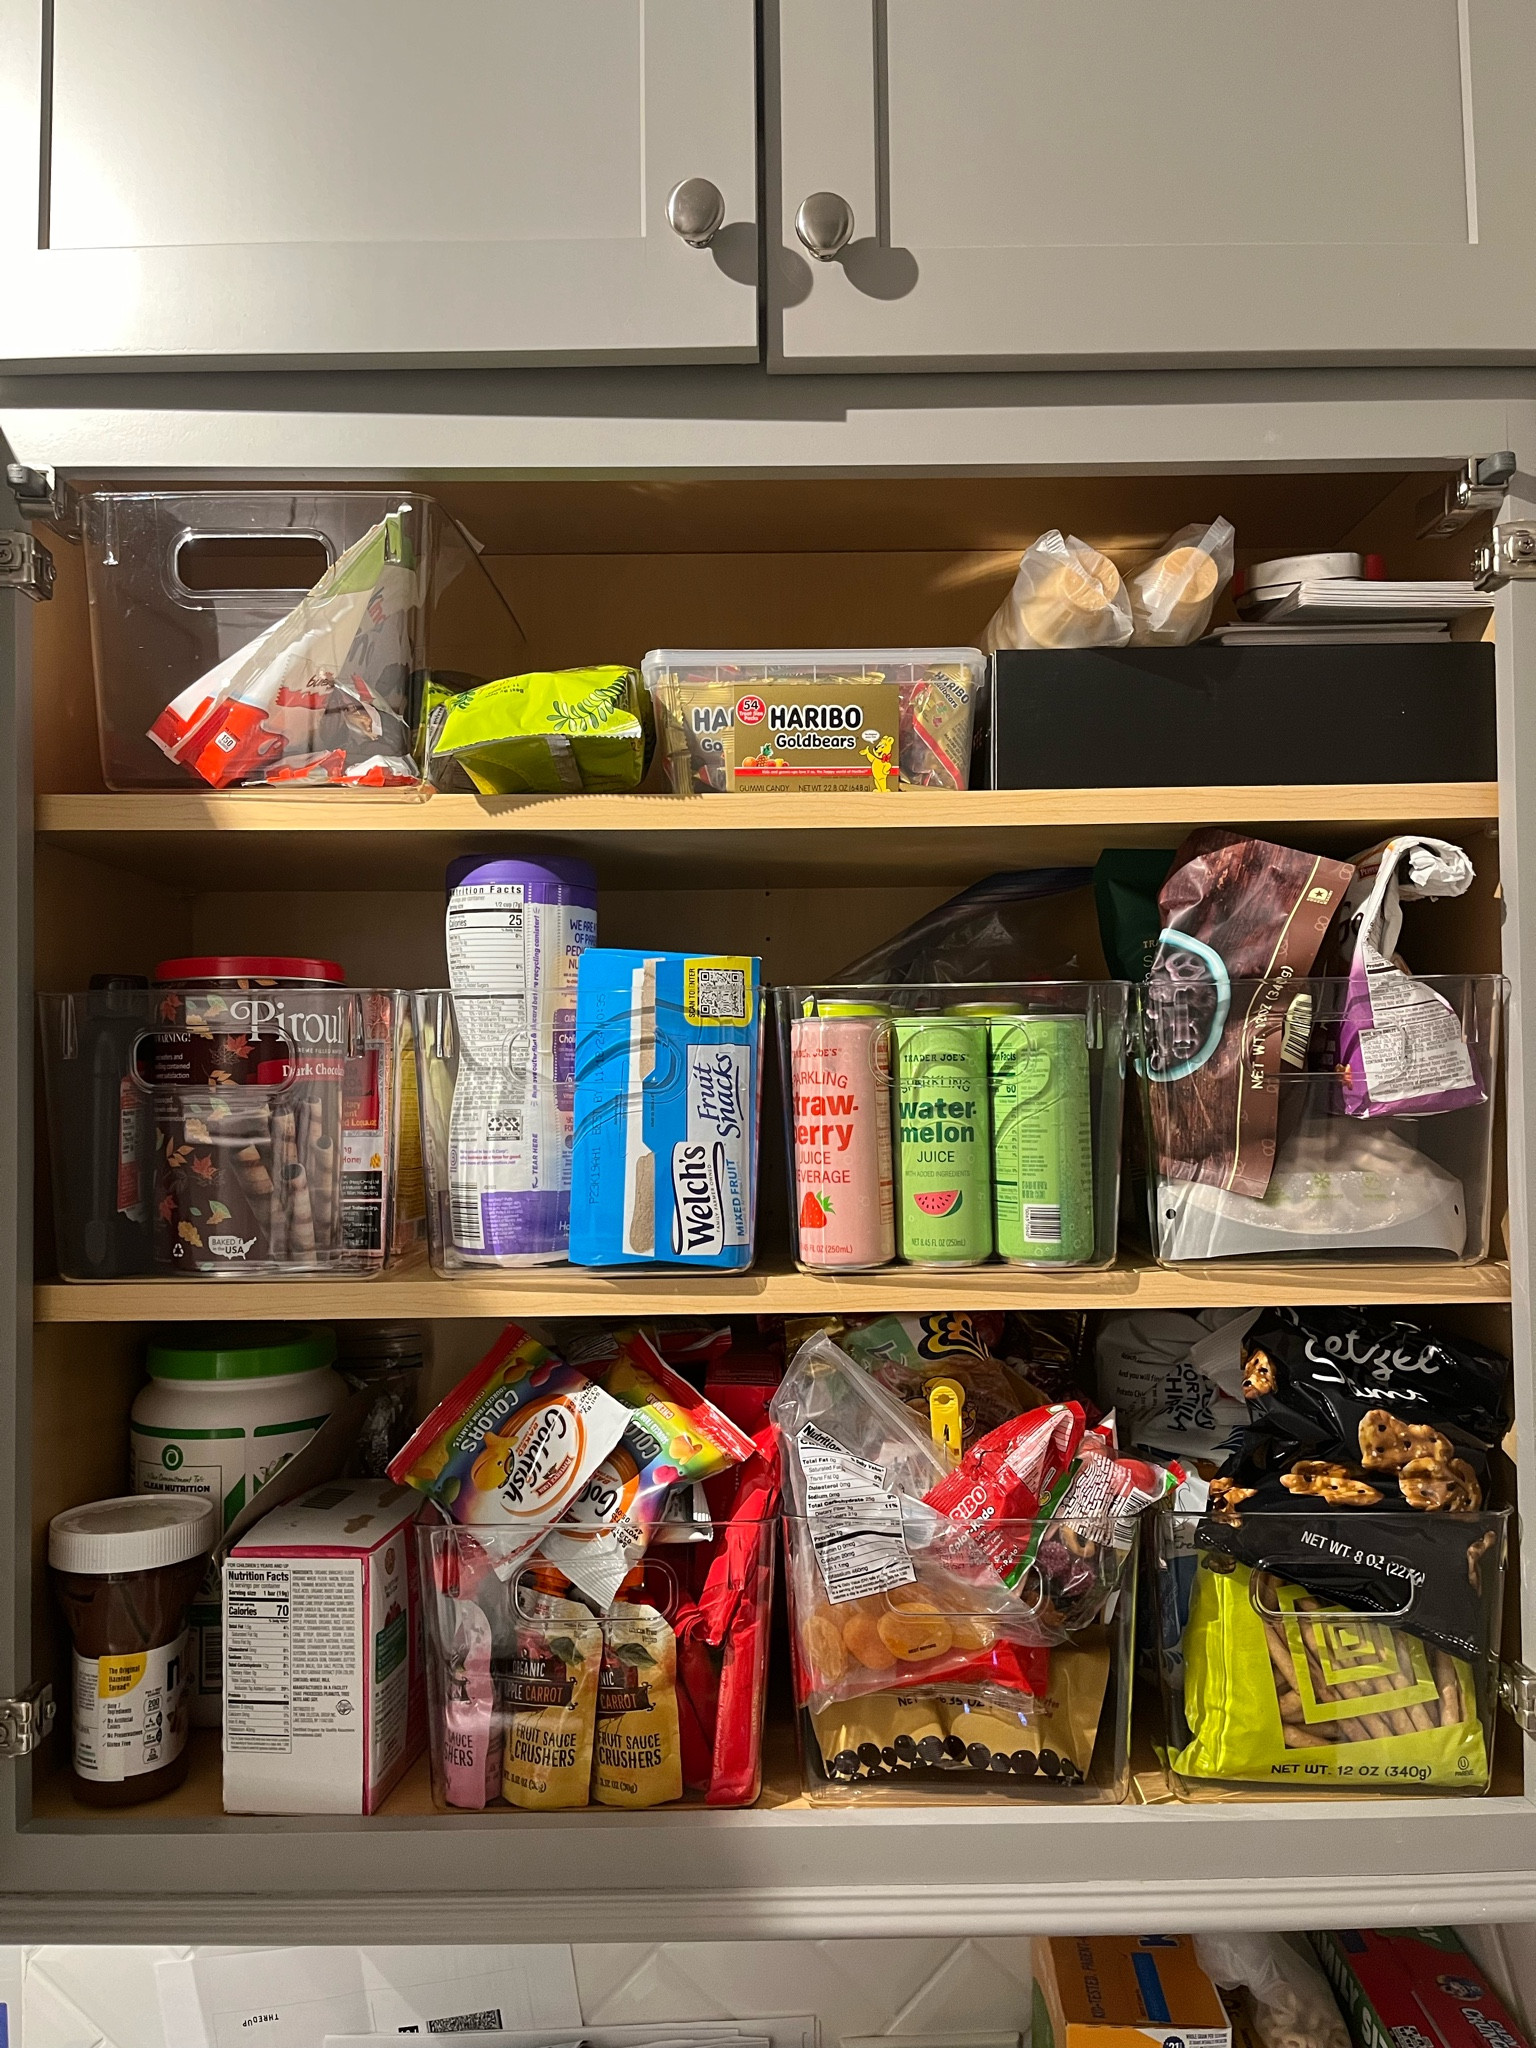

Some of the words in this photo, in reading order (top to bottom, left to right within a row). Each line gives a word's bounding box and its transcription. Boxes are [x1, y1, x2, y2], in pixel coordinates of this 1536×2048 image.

[743, 700, 759, 710] 54
[769, 706, 863, 730] HARIBO
[220, 734, 234, 747] 150
[776, 734, 856, 749] Goldbears
[740, 784, 764, 792] GUMMI
[766, 784, 790, 792] CANDY
[799, 784, 810, 792] NET
[839, 784, 848, 792] OZ
[848, 784, 870, 792] (648g)
[490, 886, 522, 894] Facts
[509, 914, 522, 926] 25
[570, 918, 582, 931] WE
[532, 916, 540, 947] canister!
[574, 932, 585, 944] OF
[532, 948, 540, 981] recycling
[688, 990, 695, 999] TO
[1253, 1032, 1266, 1056] WT.
[904, 1054, 937, 1063] TRADER
[940, 1053, 966, 1062] JOE'S
[1000, 1052, 1017, 1060] Facts
[1250, 1062, 1264, 1090] NET
[698, 1062, 714, 1121] Fruit
[1006, 1084, 1016, 1094] 60
[716, 1053, 741, 1139] Snacks
[900, 1122, 975, 1143] melon
[916, 1150, 956, 1163] JUICE
[726, 1159, 739, 1195] FRUIT
[917, 1170, 935, 1178] ADDED
[936, 1170, 971, 1178] INGREDIENTS
[679, 1144, 715, 1250] Welch's
[731, 1198, 745, 1237] MIXED
[212, 1238, 236, 1246] BAKED
[912, 1238, 920, 1247] NET
[920, 1238, 931, 1248] 8.45
[932, 1238, 938, 1247] FL
[938, 1238, 946, 1248] OZ
[946, 1238, 966, 1248] (250mL)
[226, 1246, 245, 1254] USA
[825, 1244, 853, 1254] (250mL)
[1118, 1370, 1128, 1378] And
[1129, 1372, 1140, 1380] you
[484, 1386, 507, 1409] SOURCED
[1116, 1387, 1134, 1396] Potato
[645, 1392, 674, 1420] CHEDDAR
[474, 1406, 486, 1420] FROM
[460, 1390, 519, 1453] COLORS
[456, 1418, 474, 1442] PLANTS
[516, 1422, 539, 1457] BAKED
[143, 1481, 164, 1490] CLEAN
[164, 1484, 210, 1493] NUTRITION
[824, 1498, 864, 1506] Carbohydrate
[815, 1509, 832, 1517] Dietary
[814, 1532, 836, 1542] Protein
[1300, 1530, 1328, 1549] NET
[1329, 1540, 1352, 1558] WT.
[1354, 1550, 1364, 1565] 8
[1366, 1554, 1385, 1570] OZ
[228, 1570, 265, 1581] Nutrition
[266, 1571, 290, 1582] Facts
[228, 1606, 258, 1616] Calories
[276, 1604, 290, 1616] 70
[119, 1665, 140, 1674] Original
[512, 1660, 546, 1678] ORGANIC
[109, 1675, 132, 1683] Hazelnut
[525, 1685, 564, 1703] CARROT
[148, 1698, 160, 1708] 200
[600, 1693, 637, 1710] CARROT
[107, 1708, 132, 1716] Ingredients
[516, 1724, 541, 1744] FRUIT
[542, 1731, 577, 1748] SAUCE
[598, 1732, 622, 1749] FRUIT
[626, 1733, 661, 1750] SAUCE
[514, 1740, 576, 1768] CRUSHERS
[600, 1747, 662, 1768] CRUSHERS
[1271, 1764, 1300, 1775] NET
[1304, 1764, 1332, 1776] WT.
[1337, 1766, 1354, 1776] 12
[1358, 1766, 1380, 1776] OZ
[1384, 1764, 1432, 1781] (340g)
[1084, 1976, 1106, 2018] KID-TESTED
[242, 2014, 280, 2028] THREDUP
